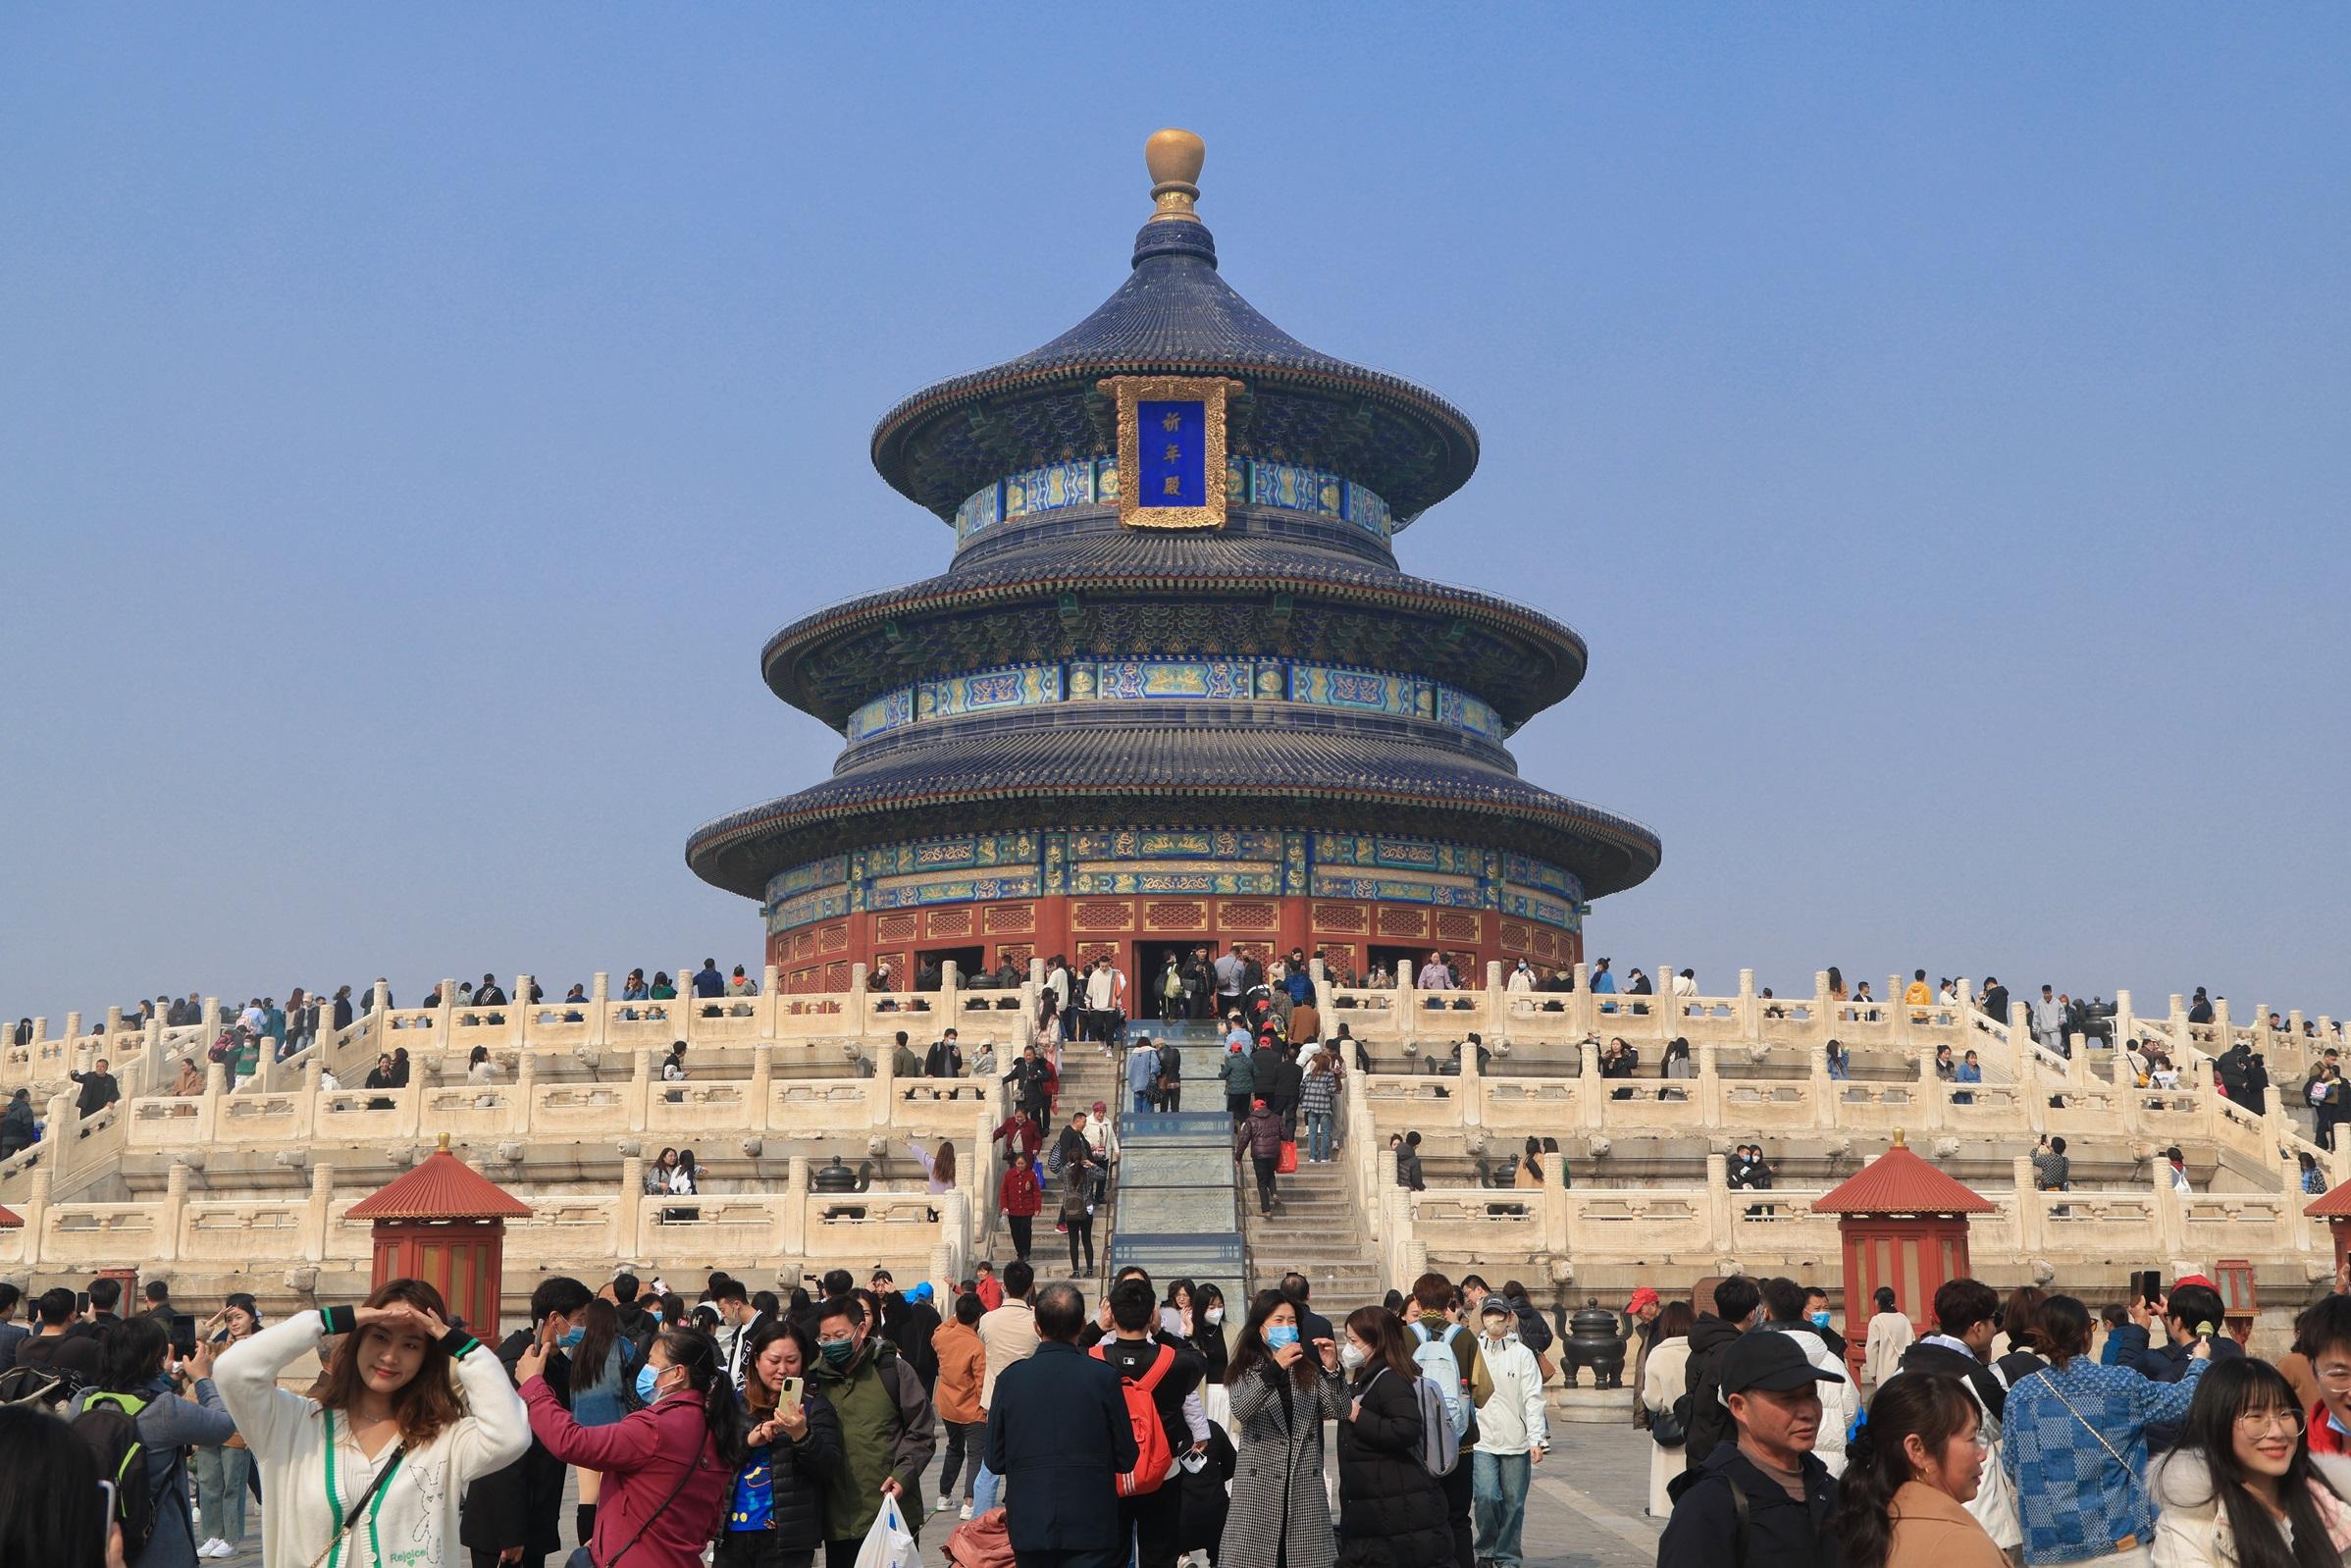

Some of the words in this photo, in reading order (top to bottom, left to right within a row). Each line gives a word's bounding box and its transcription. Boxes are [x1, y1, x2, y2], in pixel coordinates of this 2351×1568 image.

[1162, 411, 1182, 497] 祈年殿
[390, 1548, 426, 1563] Rejoice
